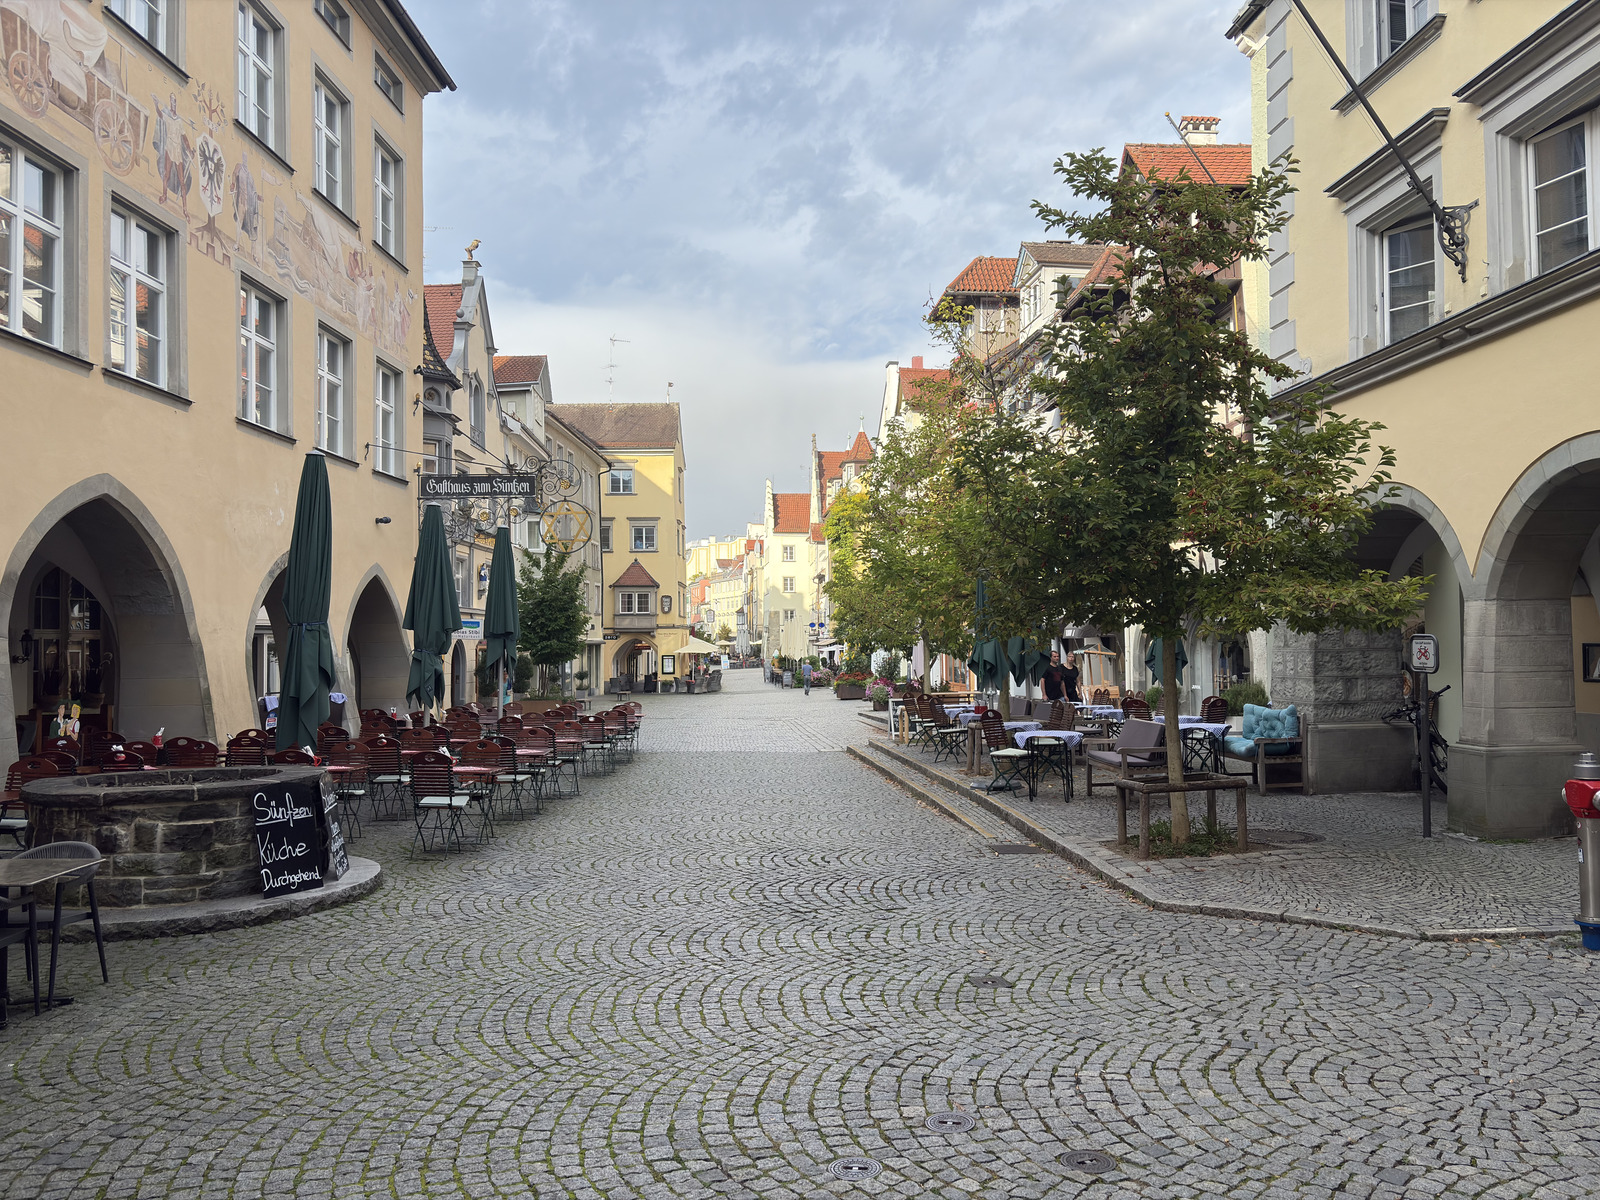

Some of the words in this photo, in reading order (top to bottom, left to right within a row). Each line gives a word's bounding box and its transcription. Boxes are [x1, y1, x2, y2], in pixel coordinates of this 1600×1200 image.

[472, 482, 491, 495] zum
[253, 792, 313, 827] Sünfzen
[256, 831, 310, 866] Küche
[260, 865, 322, 892] Durchgehend
